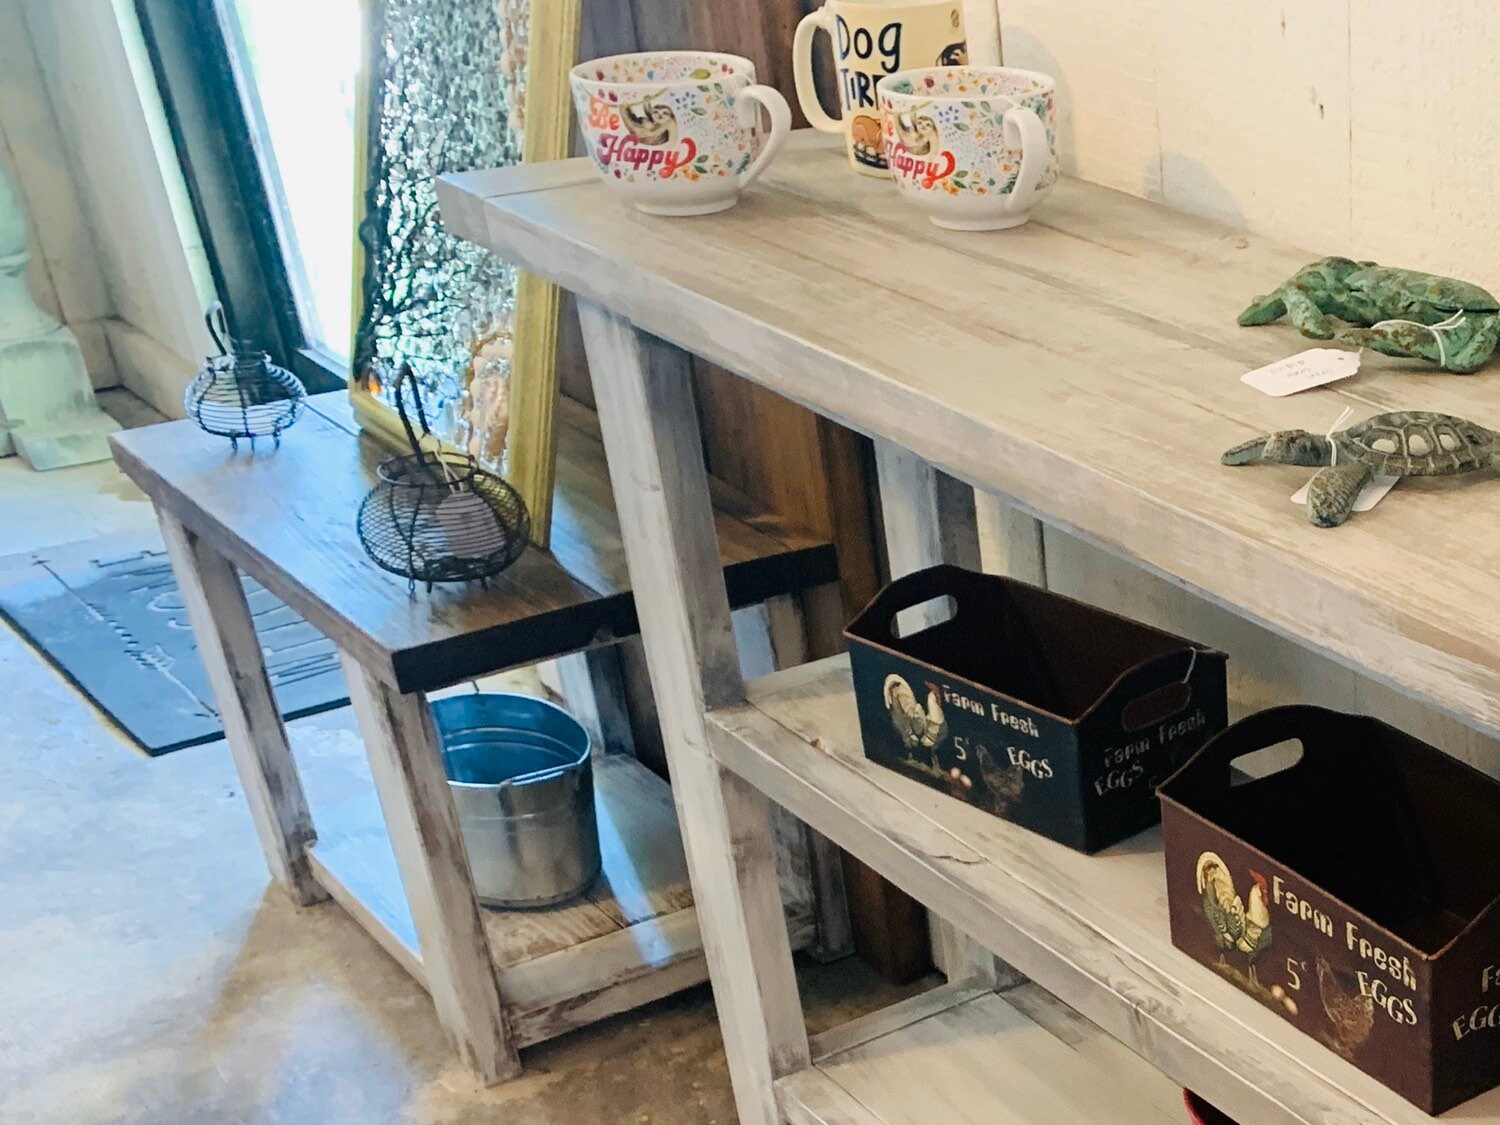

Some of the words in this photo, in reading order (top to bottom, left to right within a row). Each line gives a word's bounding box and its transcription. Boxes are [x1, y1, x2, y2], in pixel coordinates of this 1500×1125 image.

[835, 14, 902, 74] Dog
[589, 95, 620, 131] Be
[596, 133, 697, 179] Happy
[885, 139, 956, 190] Happy
[942, 683, 985, 717] Farm
[991, 703, 1039, 738] Fresh
[1006, 746, 1054, 779] EGGS
[1104, 737, 1151, 768] Farm
[1159, 708, 1206, 744] Fresh
[1094, 759, 1144, 797] EGGS
[1271, 874, 1333, 939] Farm
[1346, 921, 1417, 992] Fresh
[1355, 970, 1418, 1026] EGGS
